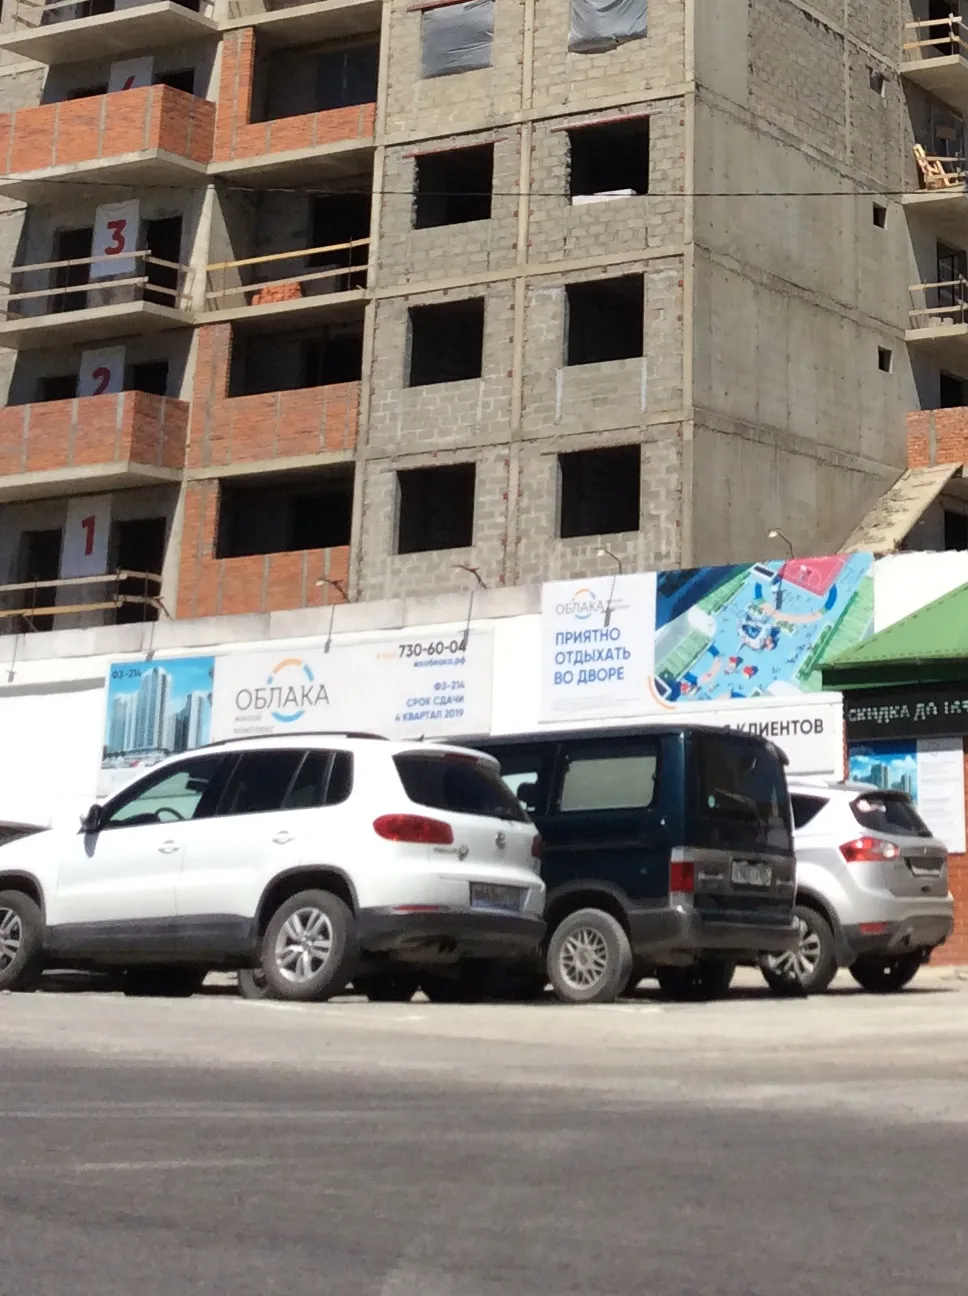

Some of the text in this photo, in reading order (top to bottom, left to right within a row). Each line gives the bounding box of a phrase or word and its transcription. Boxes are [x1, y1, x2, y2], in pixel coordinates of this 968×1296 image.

[104, 219, 127, 255] 3
[92, 367, 111, 396] 2
[82, 515, 96, 556] 1
[555, 600, 605, 616] ОБЛАКА
[555, 627, 621, 645] ПРИЯТНО
[399, 640, 467, 658] 730-60-04
[555, 647, 631, 665] ОТДЫХАТЬ
[554, 666, 625, 685] ВО ДВОРЕ
[235, 684, 330, 710] ОБЛАКА
[406, 695, 464, 707] СРОК СДАЧИ
[403, 710, 442, 721] КВАРТАЛ
[445, 708, 464, 719] 2019
